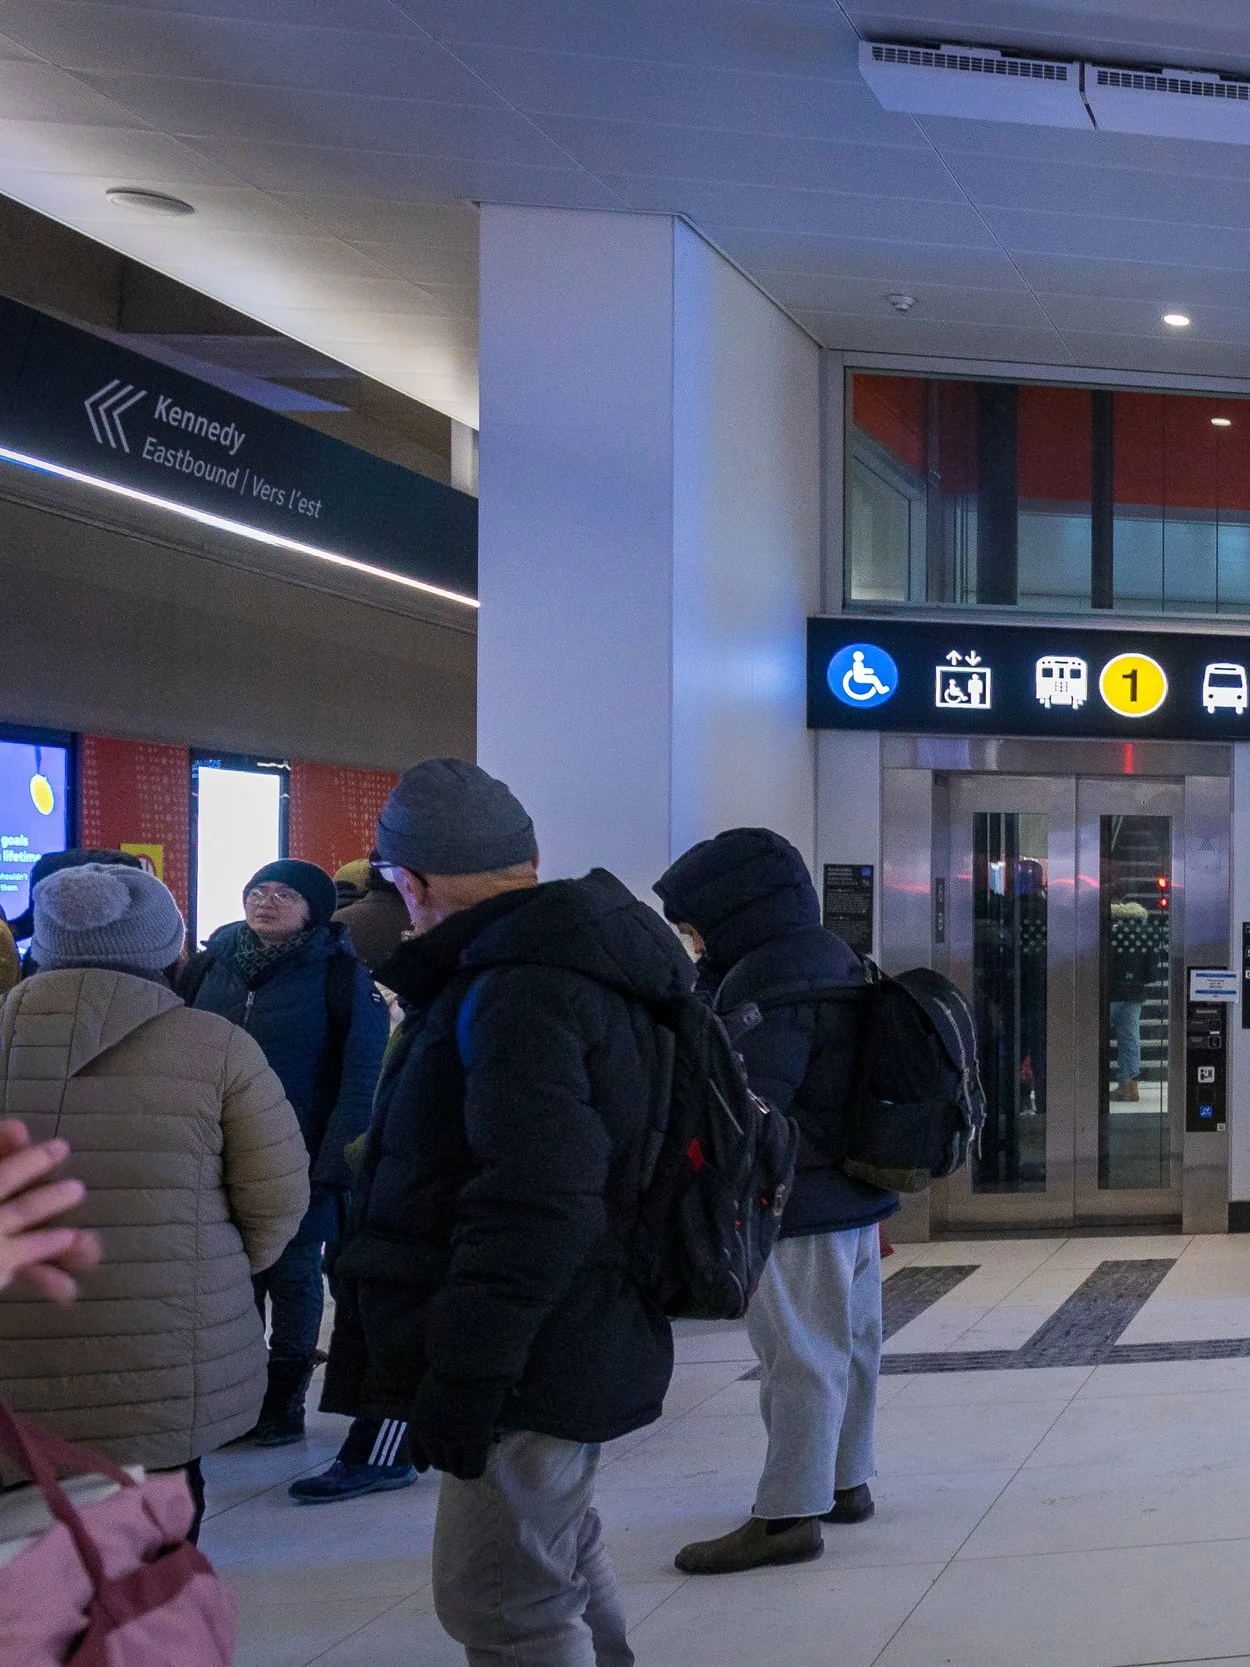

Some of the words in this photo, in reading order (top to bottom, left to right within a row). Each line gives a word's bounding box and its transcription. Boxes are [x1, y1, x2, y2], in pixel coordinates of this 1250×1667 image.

[153, 394, 246, 456] Kennedy
[141, 436, 241, 489] Eastbound
[252, 474, 286, 507] Vers
[288, 487, 323, 519] l'est
[1121, 668, 1138, 703] 1
[1, 833, 30, 849] goals
